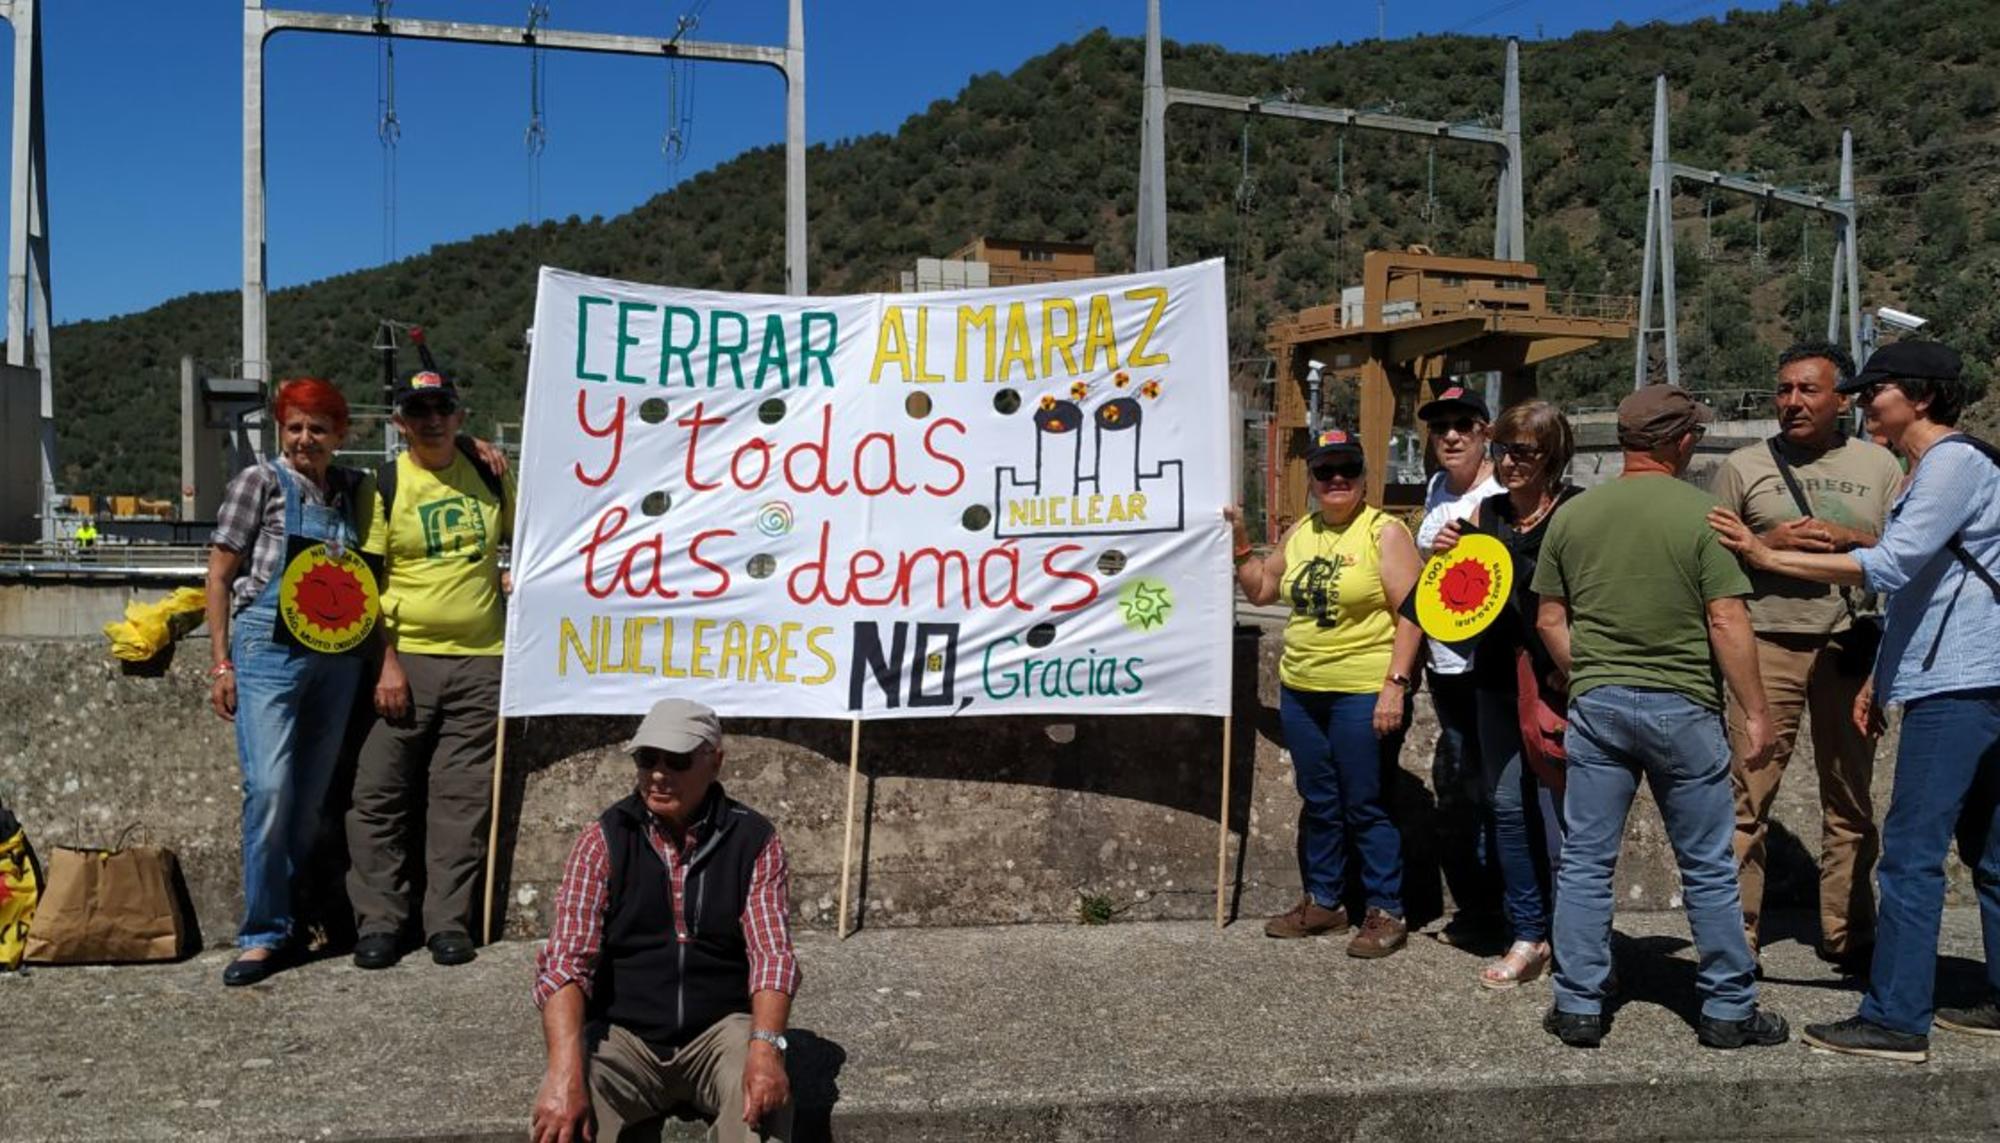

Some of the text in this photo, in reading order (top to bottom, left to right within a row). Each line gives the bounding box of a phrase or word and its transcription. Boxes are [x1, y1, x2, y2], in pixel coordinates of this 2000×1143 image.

[576, 287, 1169, 389] CERRAR ALMARAZ
[679, 404, 967, 497] todas
[579, 506, 738, 599] las
[786, 521, 1099, 613] demás
[1009, 493, 1146, 527] NUCLEAR
[559, 616, 1144, 716] NUCLEARES NO, Gracias
